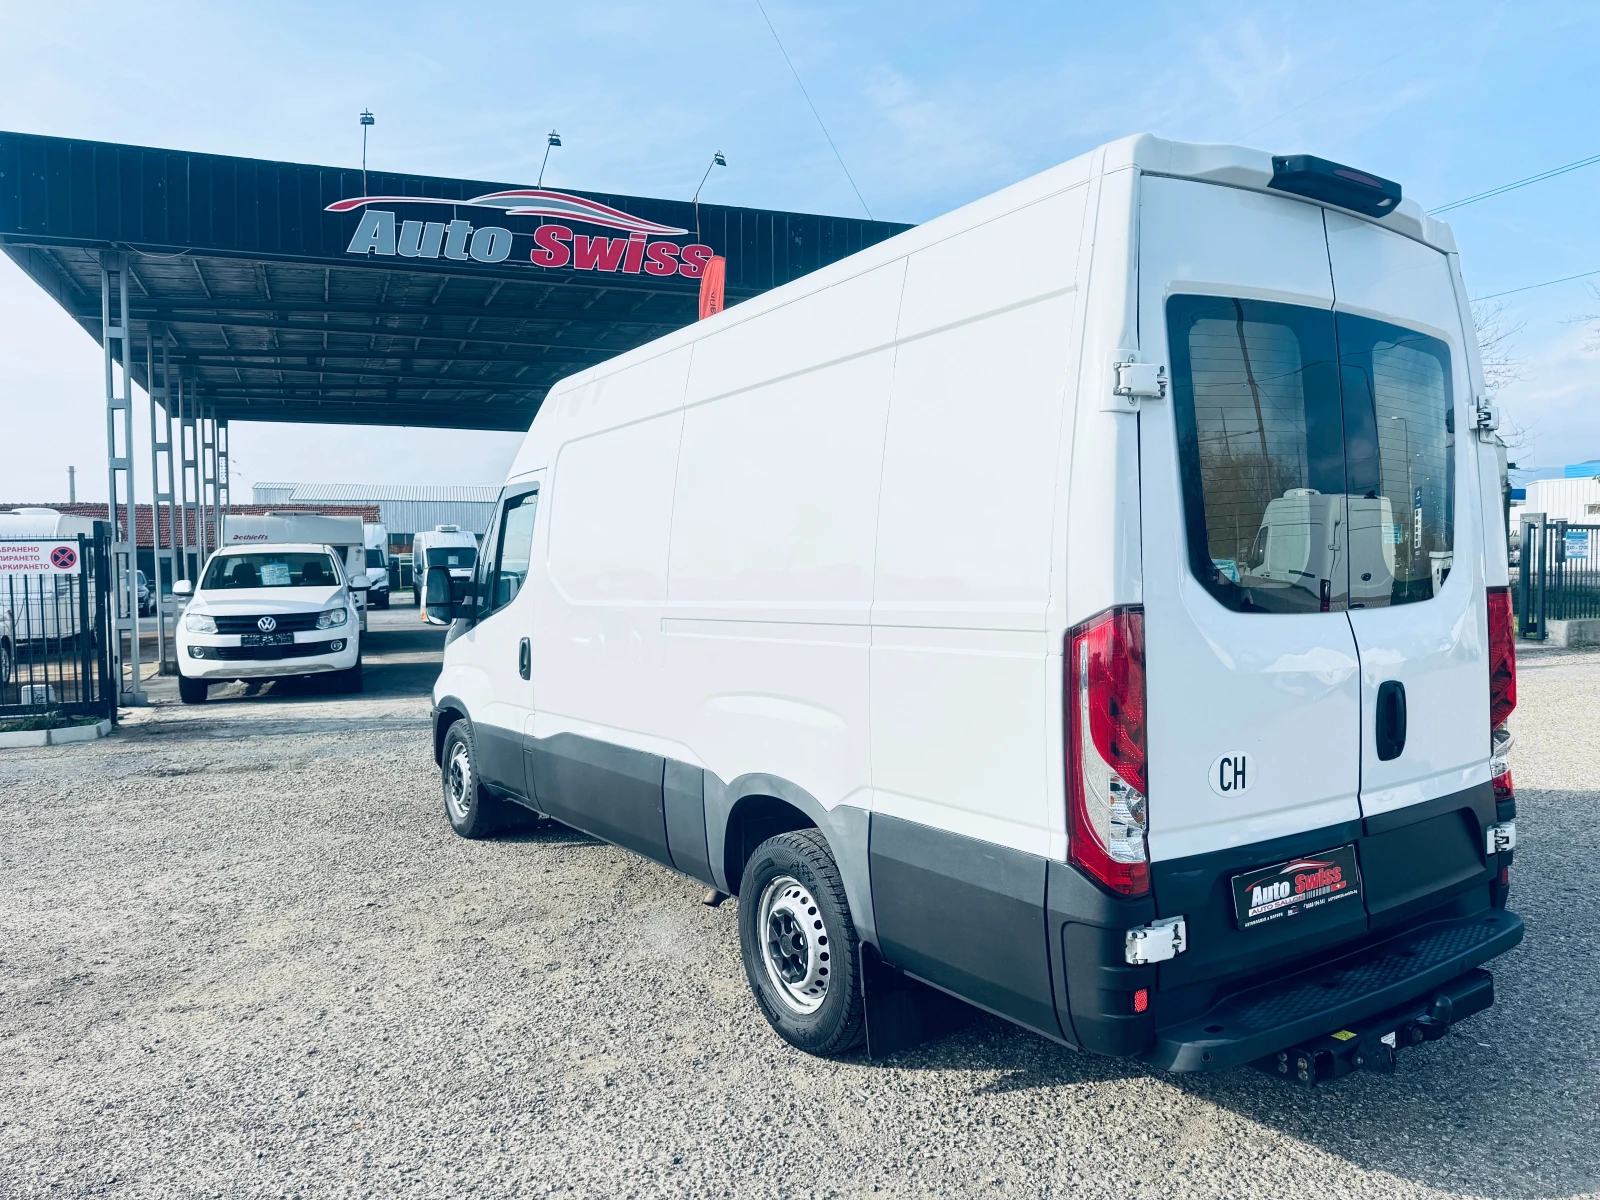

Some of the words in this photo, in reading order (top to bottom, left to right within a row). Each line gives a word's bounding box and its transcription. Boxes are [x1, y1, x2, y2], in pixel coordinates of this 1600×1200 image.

[346, 209, 513, 263] Auto
[530, 224, 714, 279] Swiss
[1219, 756, 1246, 791] CH
[1251, 881, 1290, 907] Auto
[1294, 866, 1342, 894] Swiss
[1251, 903, 1274, 915] AUTO
[1274, 893, 1305, 908] SALLON
